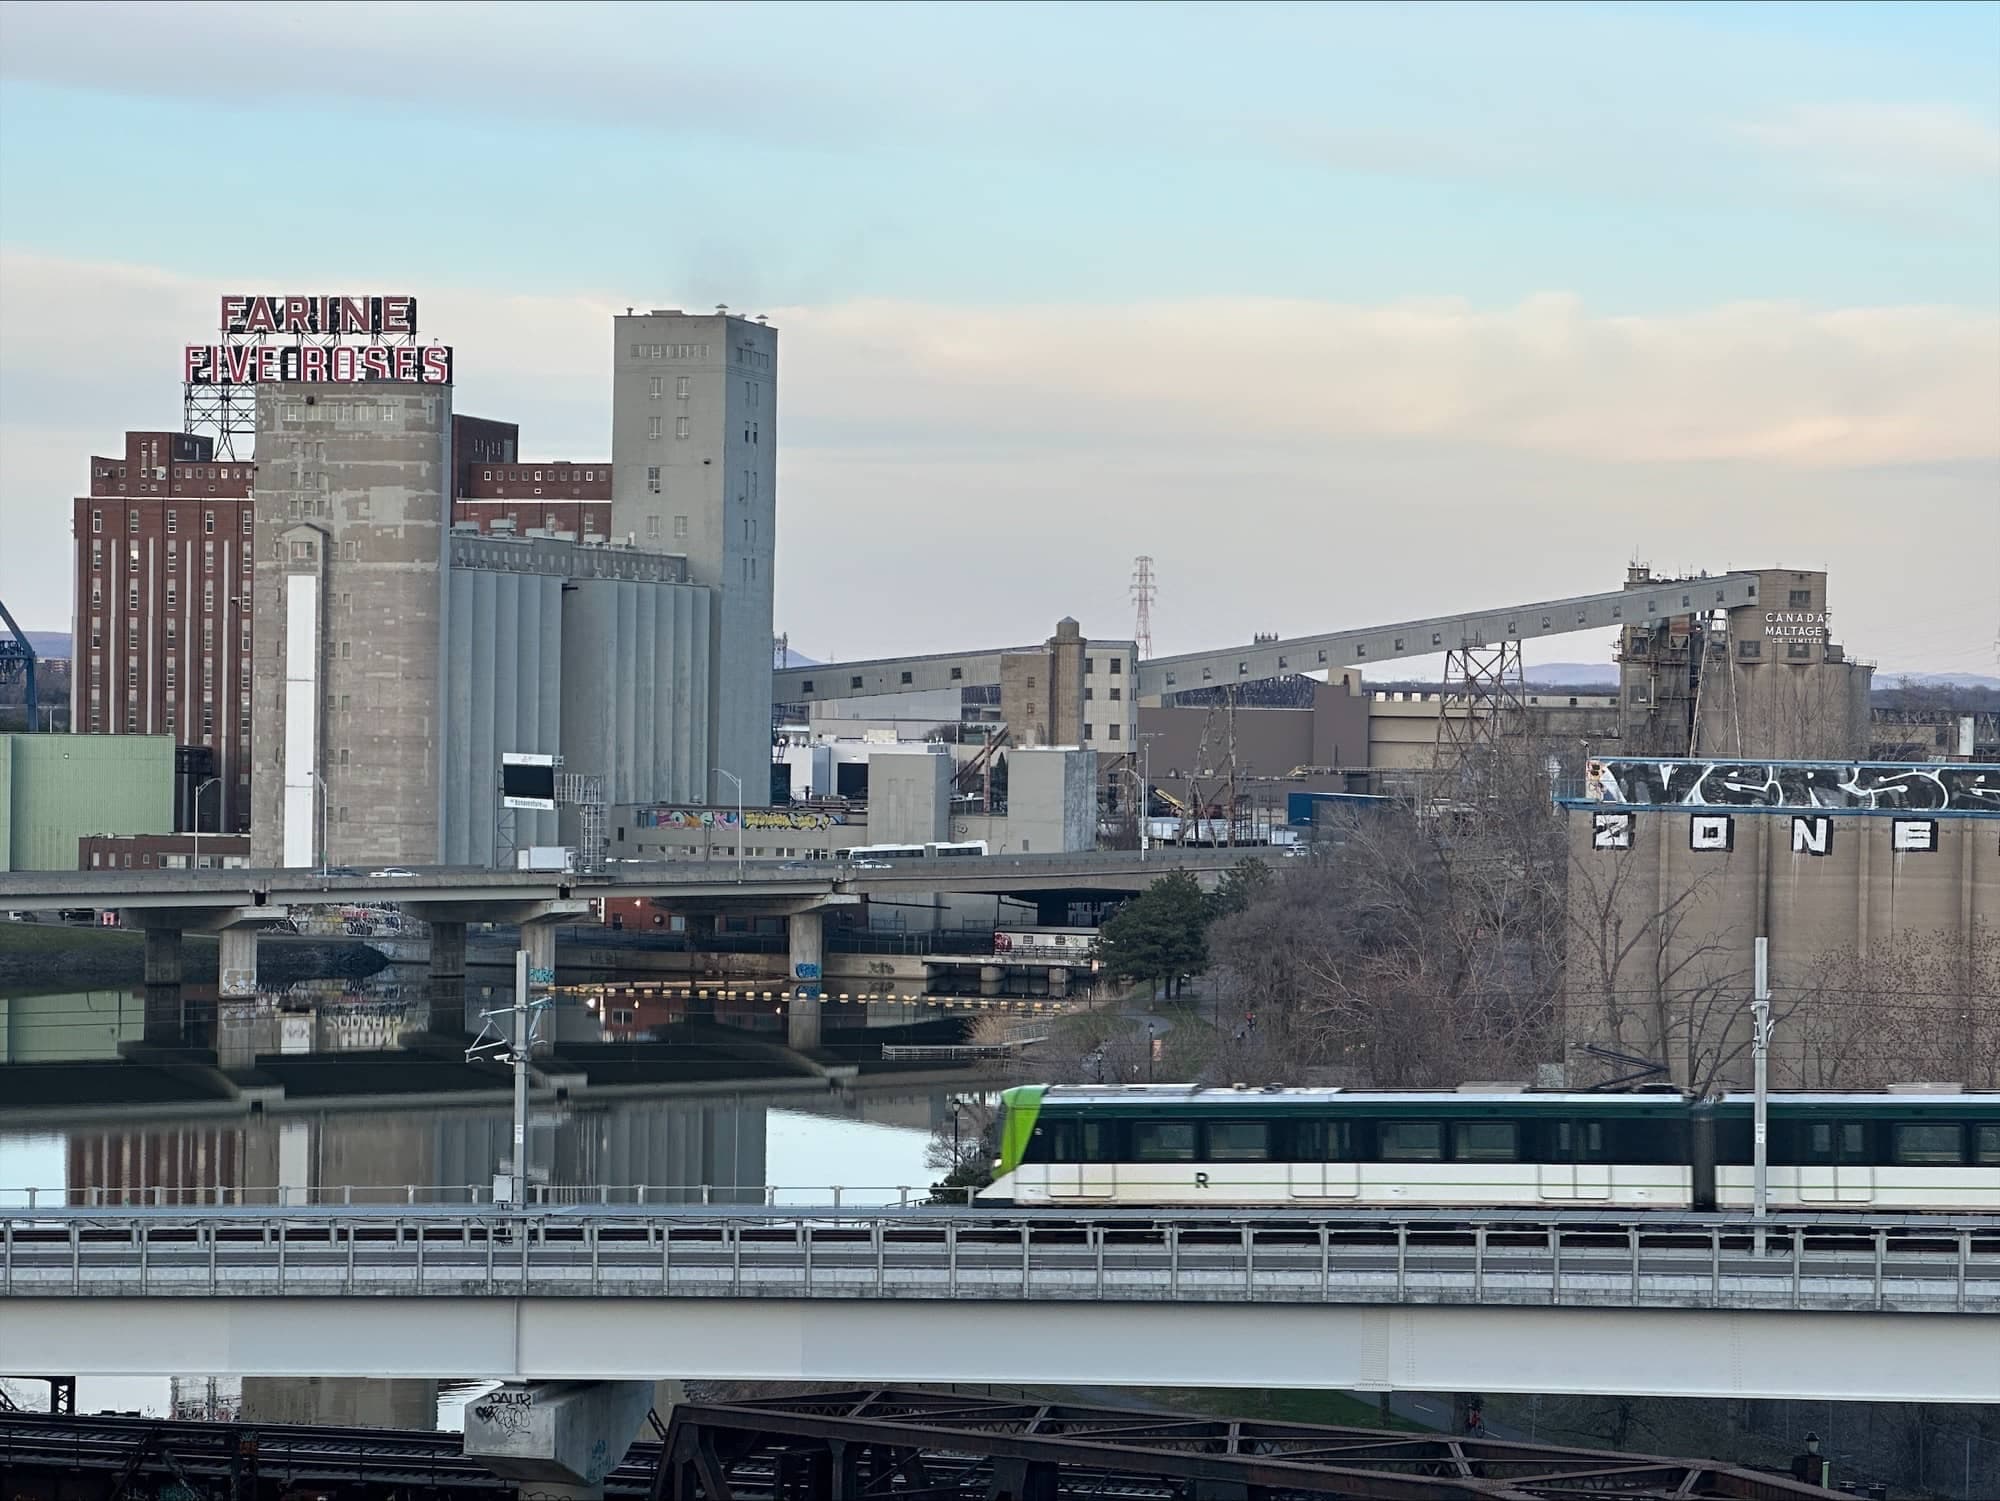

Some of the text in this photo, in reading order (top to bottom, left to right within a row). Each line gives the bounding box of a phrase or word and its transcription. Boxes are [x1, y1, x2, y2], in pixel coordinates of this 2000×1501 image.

[221, 295, 412, 334] FARINE
[184, 345, 449, 384] FIVE ROSES
[1765, 612, 1824, 623] CANADA
[1765, 626, 1822, 636] MALTAGE
[1195, 1172, 1209, 1189] R
